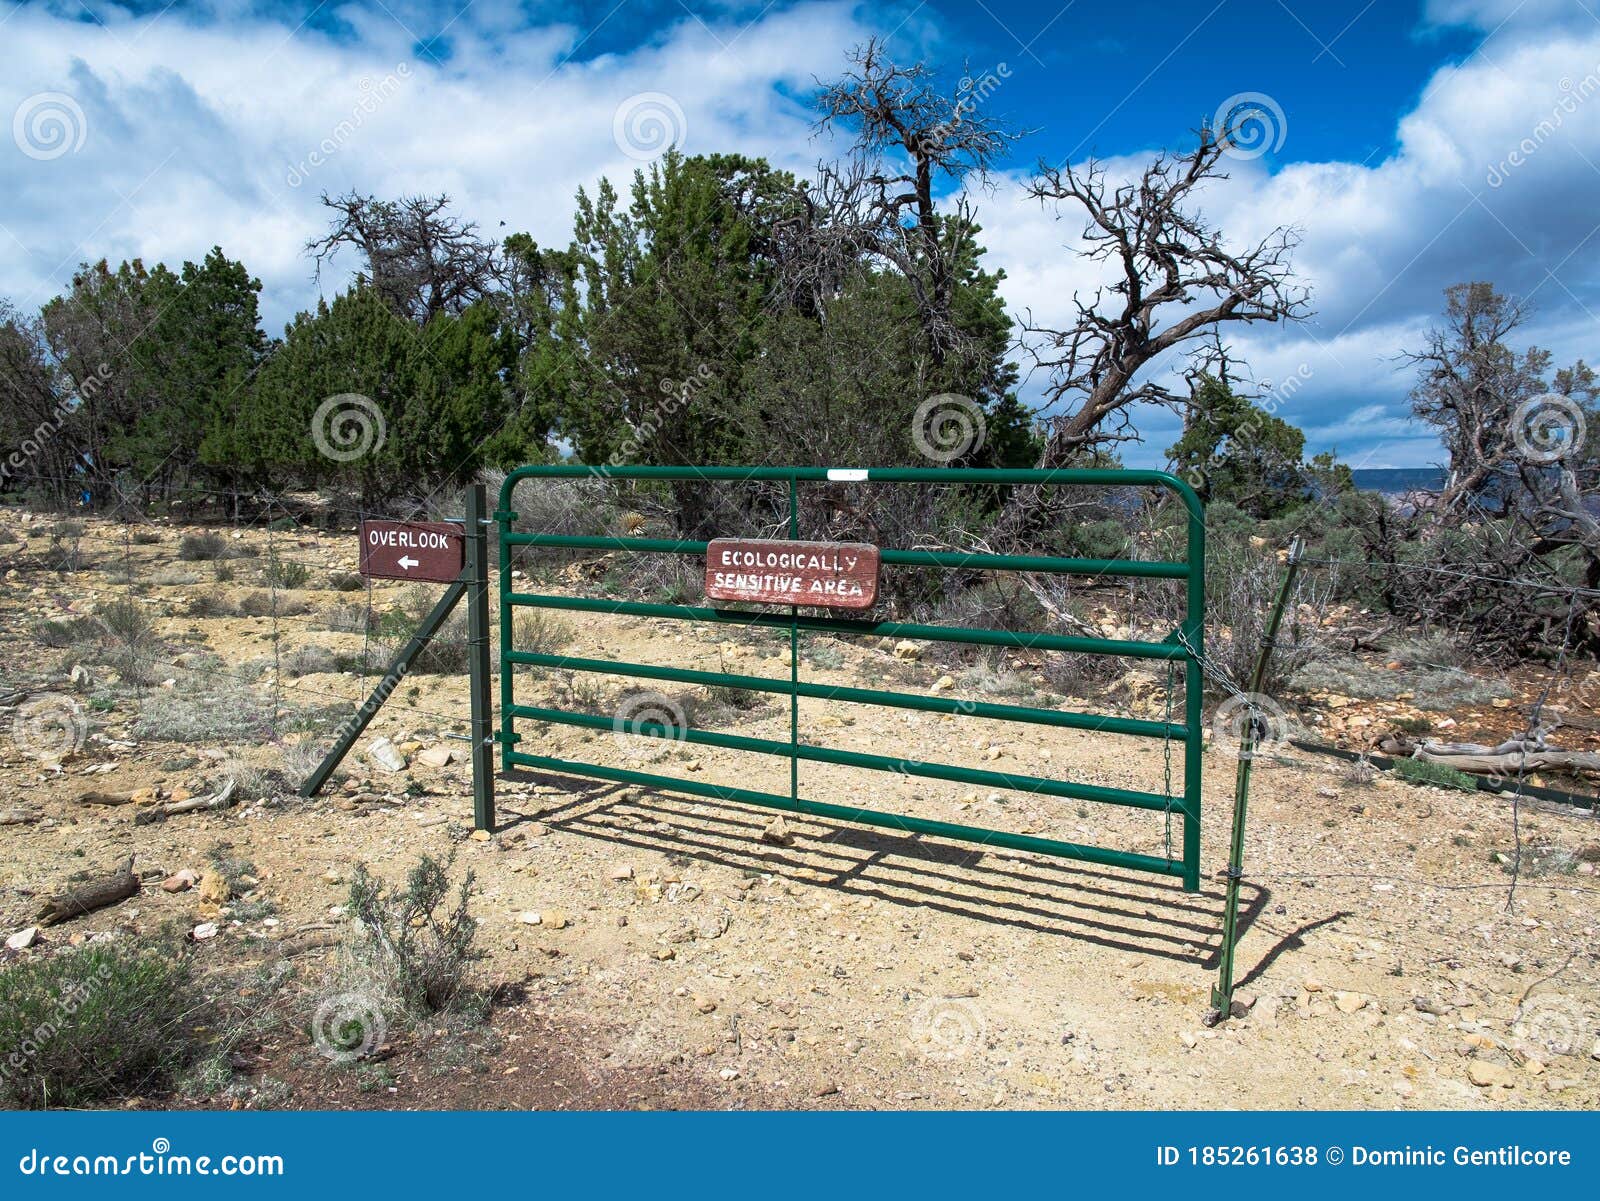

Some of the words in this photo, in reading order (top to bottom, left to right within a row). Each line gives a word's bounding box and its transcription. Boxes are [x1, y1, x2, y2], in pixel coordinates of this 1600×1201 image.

[369, 530, 449, 549] OVERLOOK
[721, 550, 858, 573] ECOLOGICALLY
[714, 572, 802, 593] SENSITIVE
[810, 579, 863, 597] AREA
